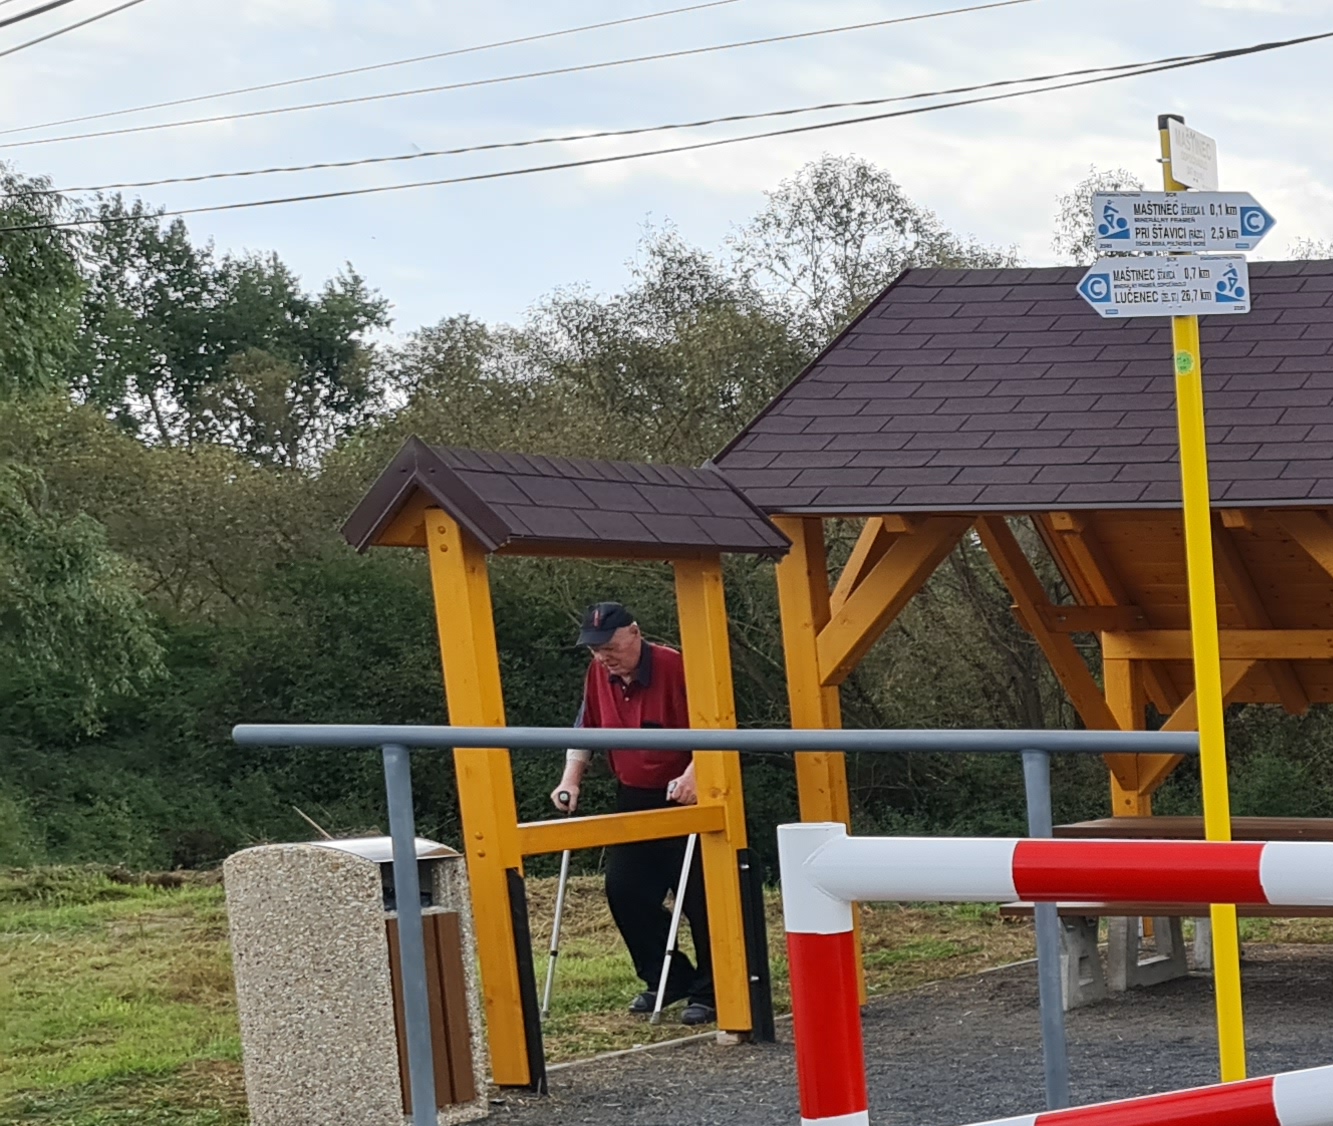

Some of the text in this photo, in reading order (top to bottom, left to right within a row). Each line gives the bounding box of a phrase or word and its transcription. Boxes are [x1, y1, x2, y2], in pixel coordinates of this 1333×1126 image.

[1133, 200, 1179, 216] MAŠTINEC
[1210, 203, 1223, 217] 0,1
[1225, 203, 1238, 216] km
[1135, 227, 1150, 239] PRI
[1210, 226, 1225, 241] 2,5
[1226, 227, 1239, 239] km
[1113, 266, 1155, 281] MAŠTINEC
[1184, 267, 1196, 281] 0,7
[1198, 267, 1210, 278] km
[1114, 286, 1159, 304] LUČENEC
[1181, 289, 1198, 304] 26,7
[1200, 289, 1212, 301] km
